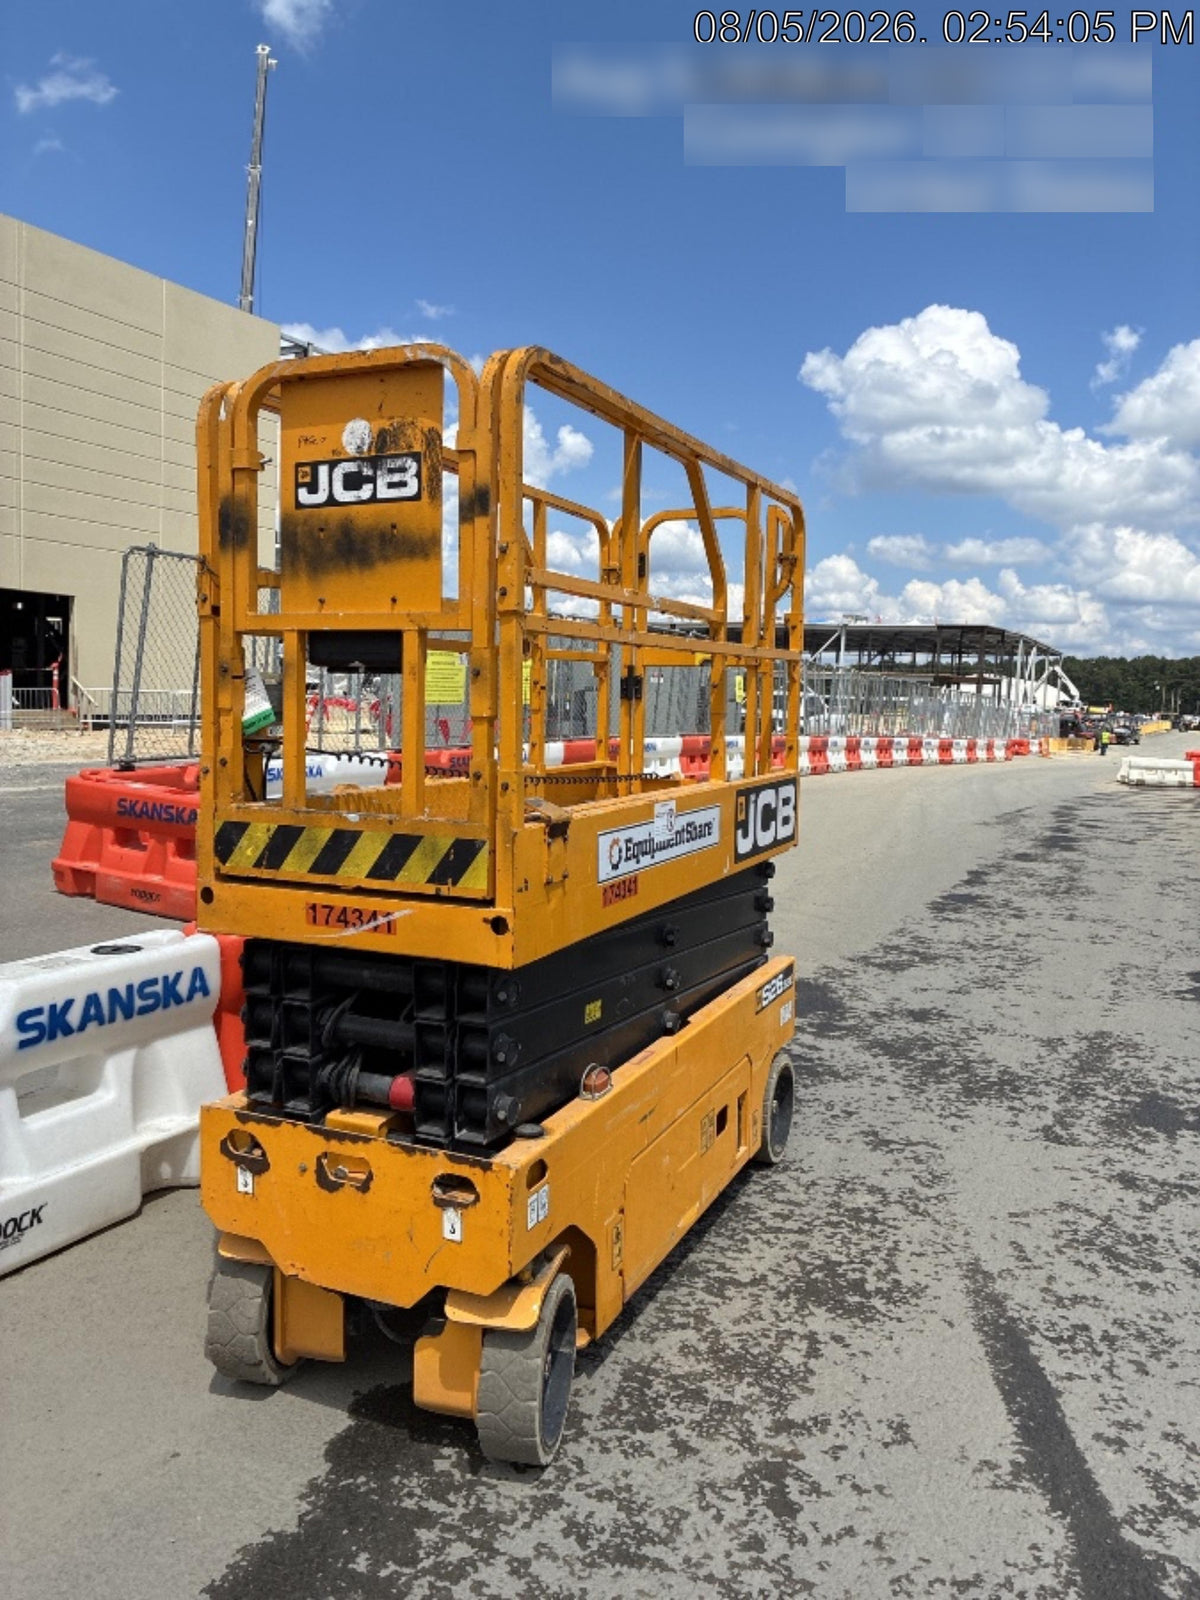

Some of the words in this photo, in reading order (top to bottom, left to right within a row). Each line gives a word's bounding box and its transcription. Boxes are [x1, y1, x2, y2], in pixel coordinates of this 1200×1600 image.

[297, 457, 419, 505] JCB
[117, 798, 198, 825] SKANSKA
[737, 784, 795, 854] JCB
[308, 903, 392, 934] 174341
[16, 966, 210, 1050] SKANSKA
[0, 1202, 48, 1240] OCK
